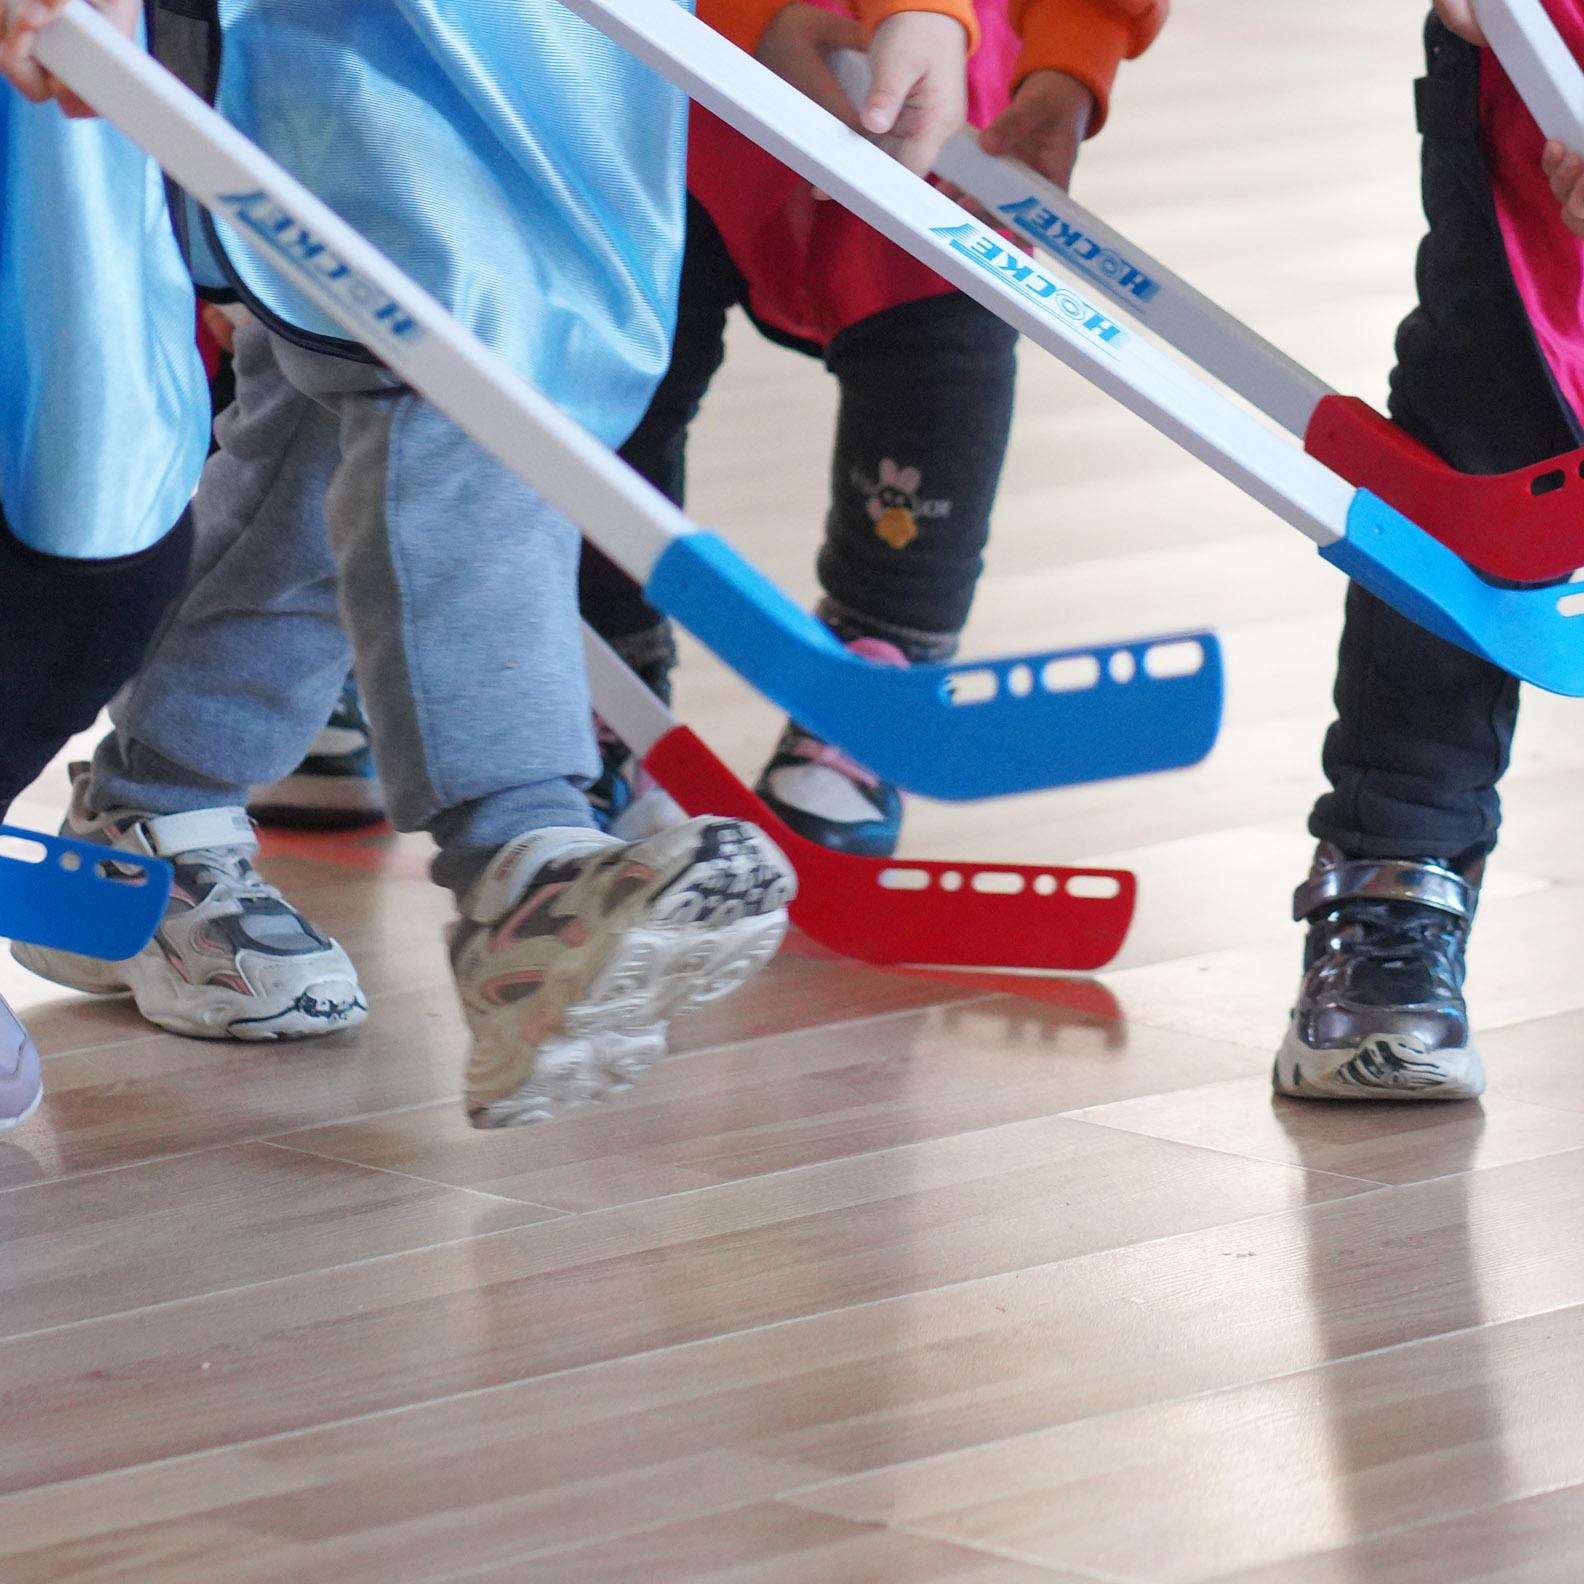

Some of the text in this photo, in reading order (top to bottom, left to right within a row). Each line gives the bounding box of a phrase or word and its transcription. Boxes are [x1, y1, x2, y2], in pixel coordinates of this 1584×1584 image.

[218, 190, 417, 339] HOCKEY
[928, 223, 1124, 346] HOCKEY
[996, 195, 1160, 304] HOCKEY
